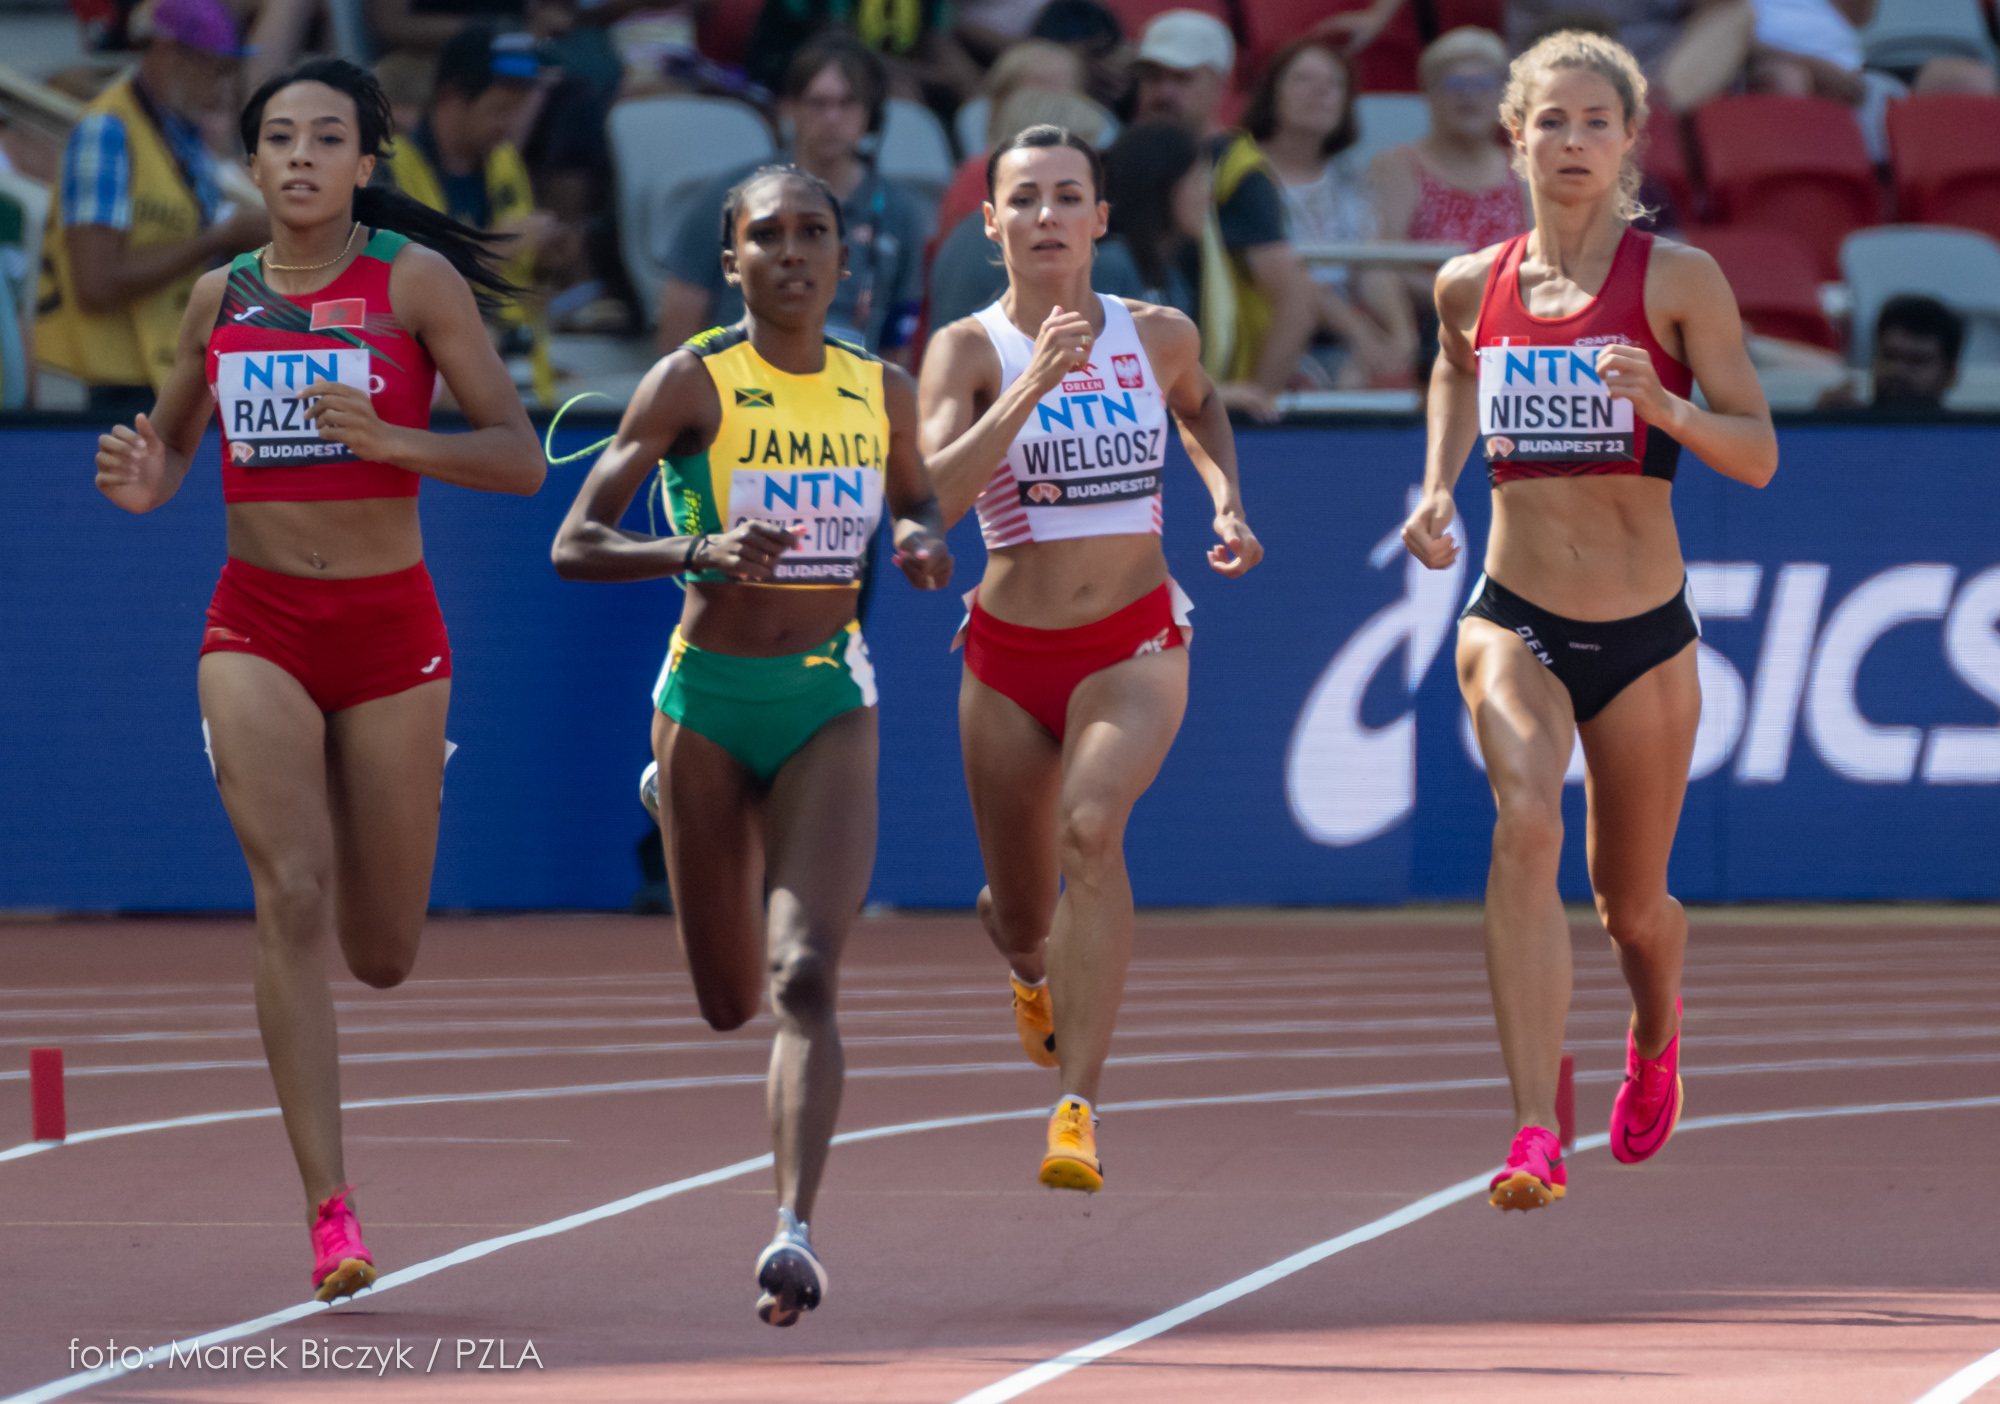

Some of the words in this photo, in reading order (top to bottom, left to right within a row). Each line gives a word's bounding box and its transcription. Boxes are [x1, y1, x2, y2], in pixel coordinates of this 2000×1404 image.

[243, 353, 338, 392] NTN
[1505, 349, 1601, 386] NTN
[1064, 381, 1103, 392] ORLEN
[234, 396, 327, 433] RAZI
[1037, 392, 1138, 434] NTN
[1490, 395, 1613, 429] NISSEN
[259, 443, 344, 458] BUDAPEST
[738, 429, 884, 472] JAMAICA
[1023, 428, 1160, 475] WIELGOSZ
[1518, 439, 1603, 453] BUDAPEST
[1605, 440, 1625, 453] 23
[764, 470, 864, 511] NTN
[1066, 478, 1144, 499] BUDAPEST
[1515, 626, 1553, 666] DEN
